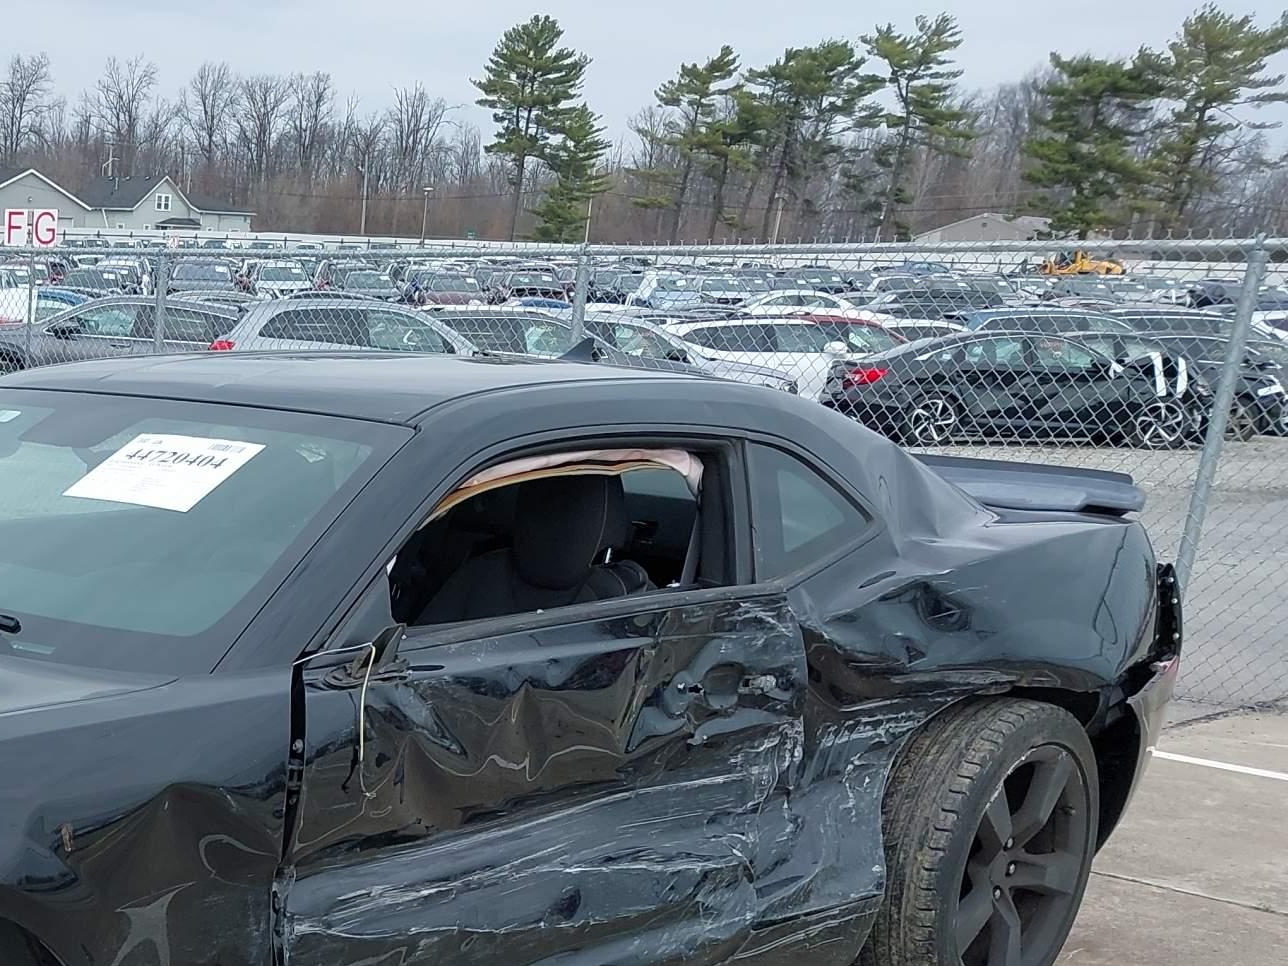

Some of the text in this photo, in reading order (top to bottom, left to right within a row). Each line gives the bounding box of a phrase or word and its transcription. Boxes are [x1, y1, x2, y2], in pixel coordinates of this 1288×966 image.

[8, 211, 55, 244] F G
[125, 448, 229, 470] 44720404
